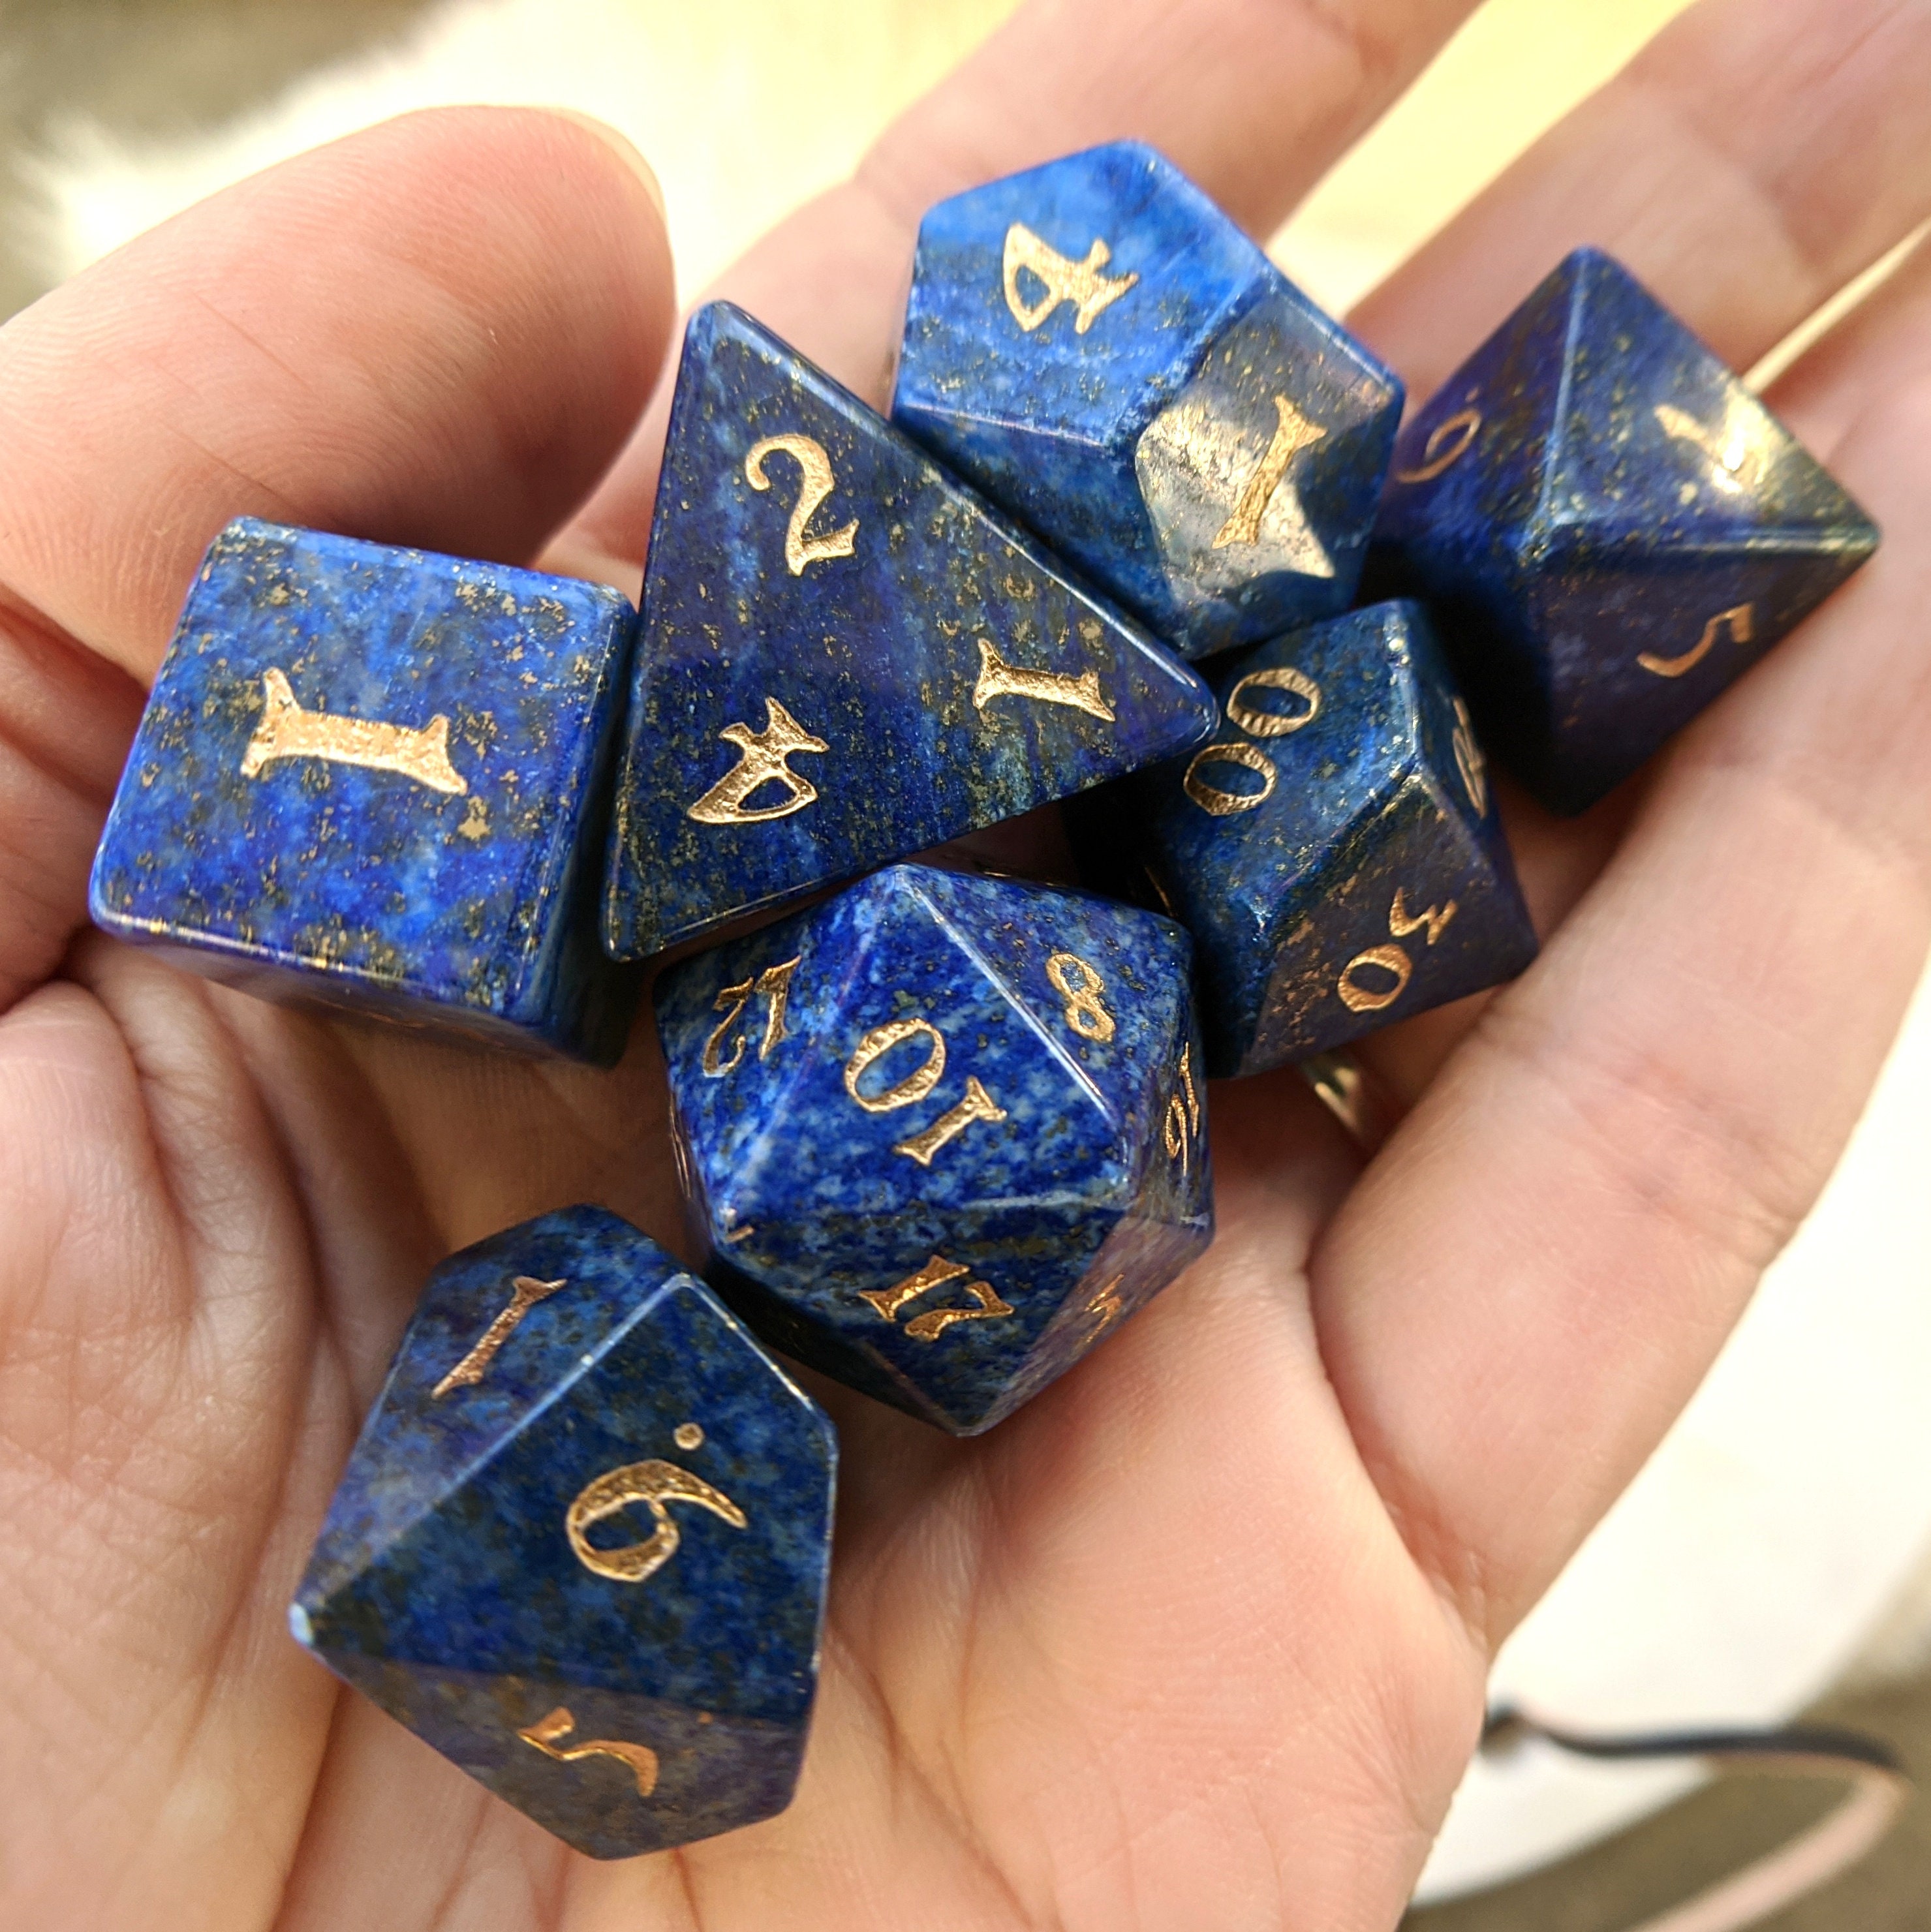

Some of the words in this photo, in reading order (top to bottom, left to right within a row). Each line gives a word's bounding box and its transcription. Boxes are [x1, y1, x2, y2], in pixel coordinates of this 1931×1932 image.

[1003, 222, 1140, 335] 4
[745, 433, 859, 577] 2
[1212, 394, 1328, 549] 1
[972, 637, 1116, 722] 1
[1637, 602, 1754, 679] 5
[241, 667, 468, 795] 1
[687, 696, 829, 824] 4
[1184, 666, 1322, 816] 00
[1047, 953, 1116, 1043] 8
[1338, 887, 1458, 1013] 30
[702, 955, 802, 1078] 12
[844, 1017, 1007, 1166] 10
[431, 1276, 567, 1400] 1
[860, 1255, 1015, 1341] 17
[519, 1707, 659, 1796] 5
